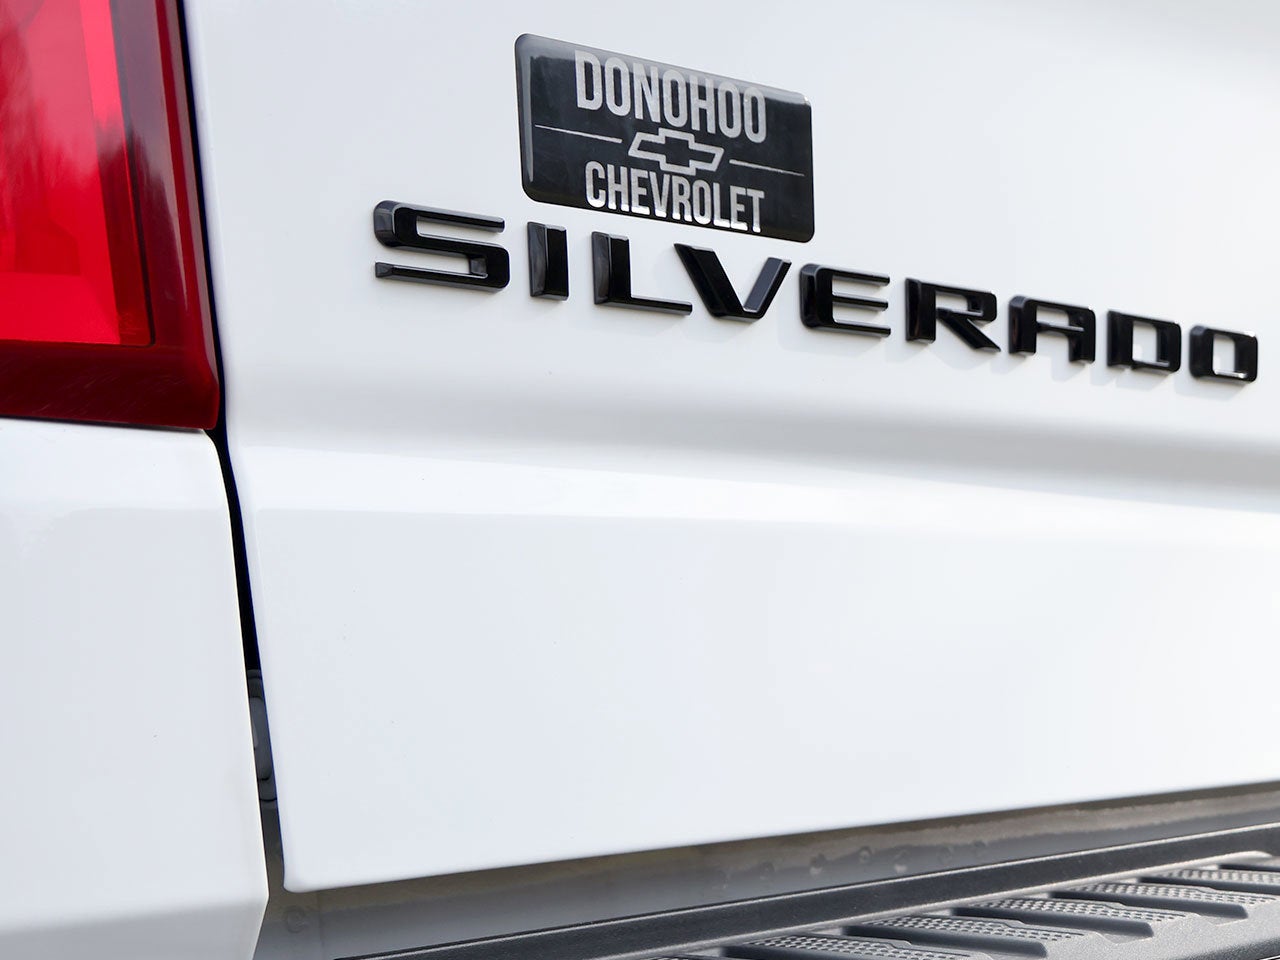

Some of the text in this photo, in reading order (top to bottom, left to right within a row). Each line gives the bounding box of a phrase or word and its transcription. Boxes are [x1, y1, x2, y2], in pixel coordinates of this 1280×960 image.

[574, 49, 767, 144] DONOHOO
[584, 160, 766, 234] CHEVROLET
[373, 200, 1259, 383] SILVERADO
